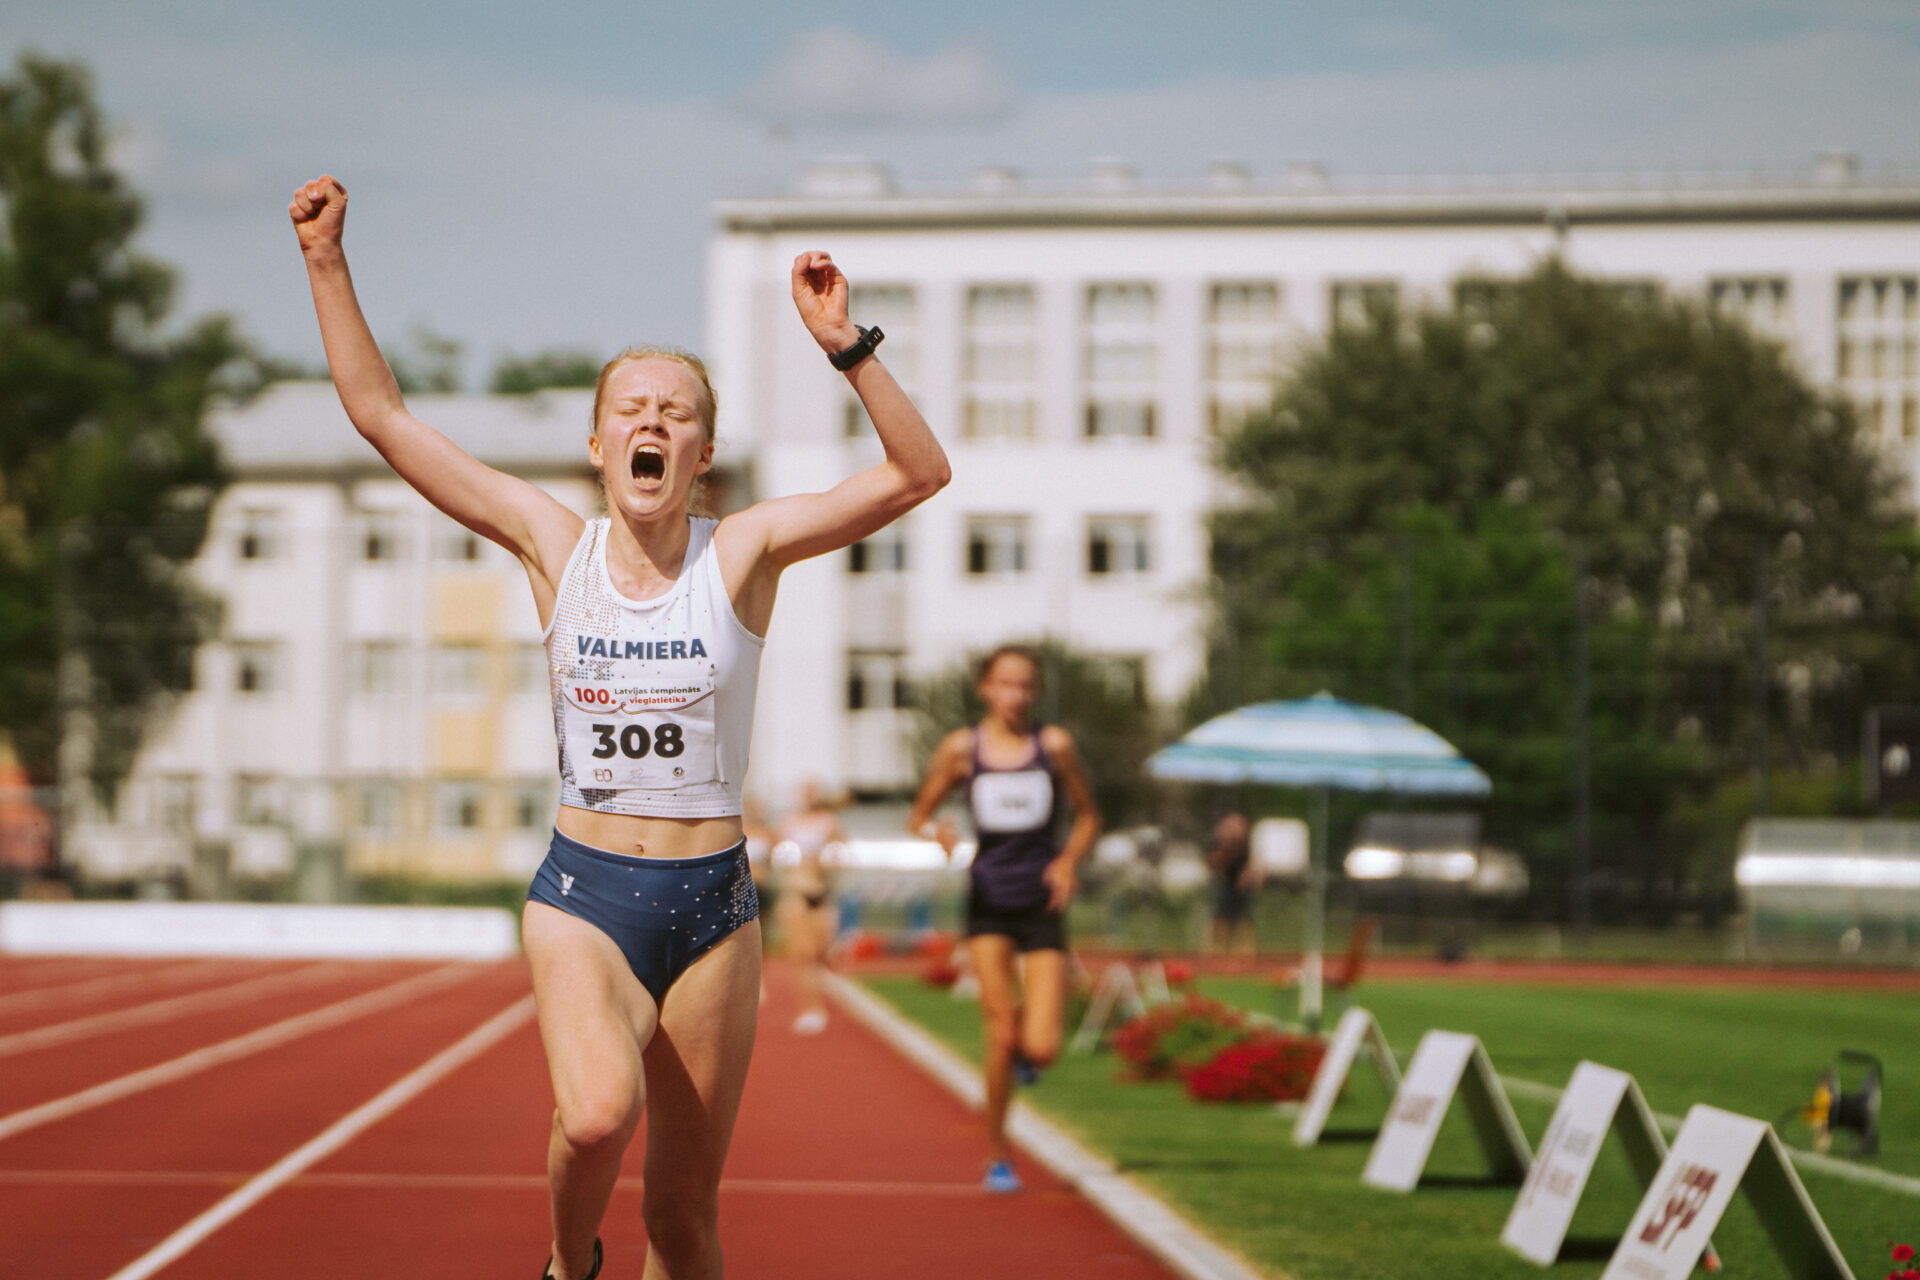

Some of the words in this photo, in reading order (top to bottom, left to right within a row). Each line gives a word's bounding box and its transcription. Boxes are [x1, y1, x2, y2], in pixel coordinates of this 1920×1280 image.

[577, 635, 708, 660] VALMIERA
[574, 687, 617, 705] 100.
[614, 688, 649, 696] Latvijas
[650, 686, 701, 696] čempionāts
[591, 723, 685, 760] 308
